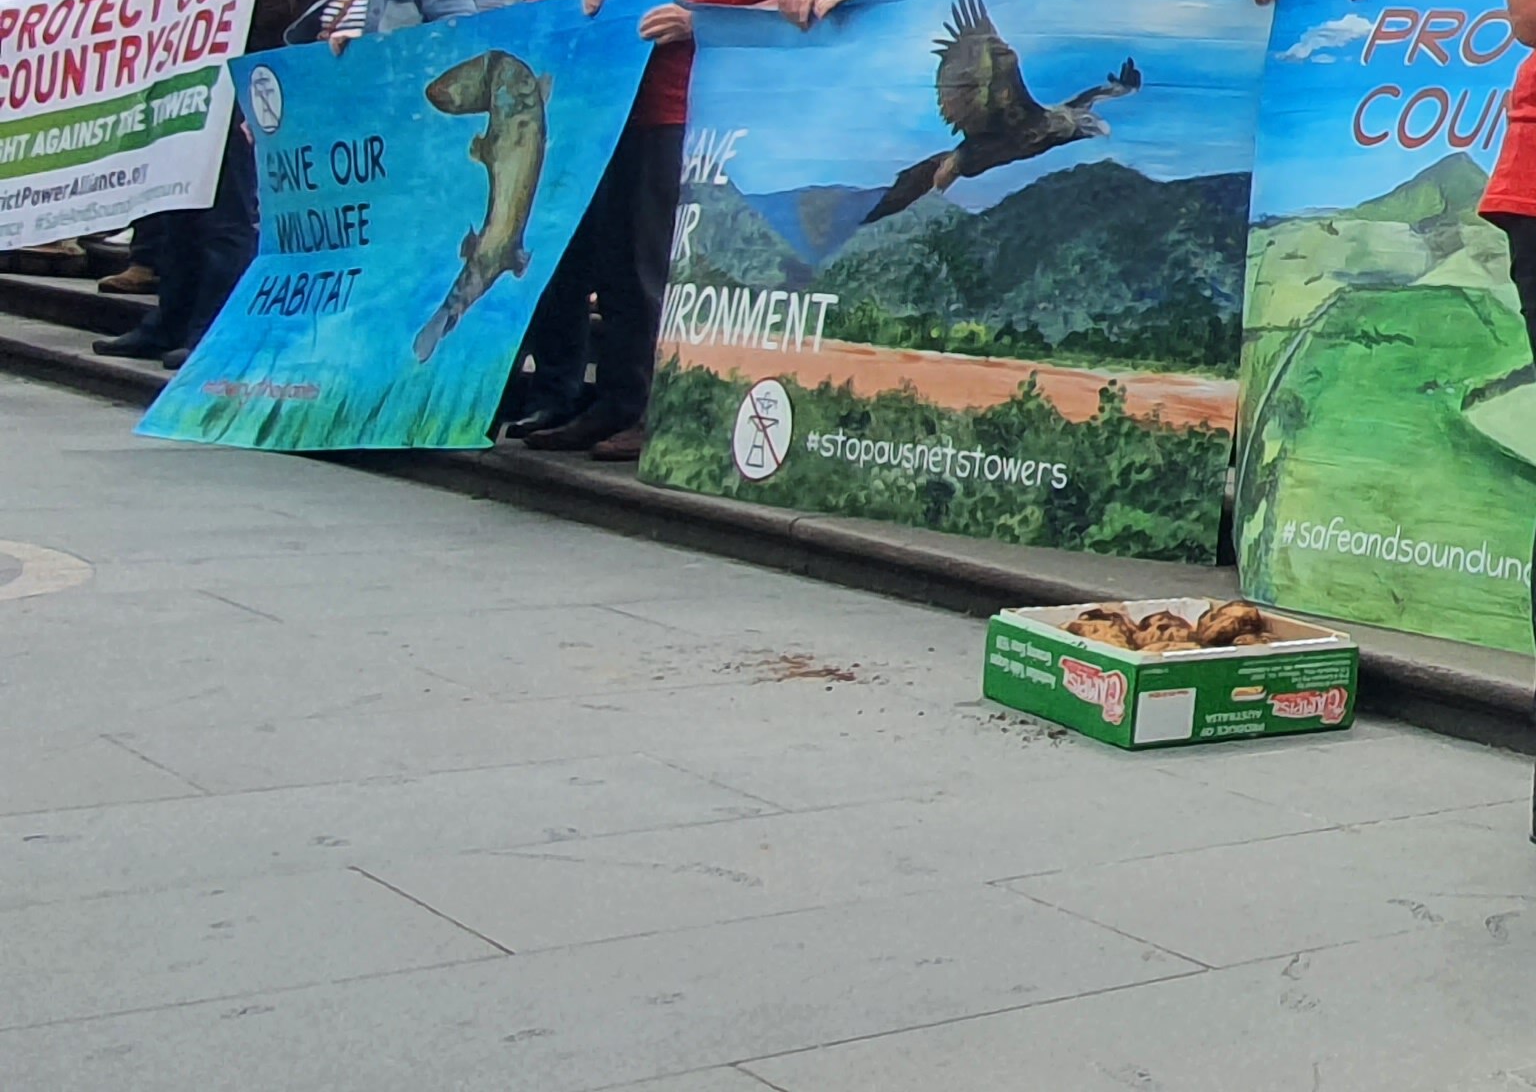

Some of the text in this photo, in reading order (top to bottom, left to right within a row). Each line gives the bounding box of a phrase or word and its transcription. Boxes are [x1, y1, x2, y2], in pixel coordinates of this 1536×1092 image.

[31, 115, 118, 157] AGAINST
[267, 135, 386, 193] SAVE OUR
[276, 203, 370, 254] WILDLIFE
[247, 268, 362, 317] HABITAT
[806, 430, 1067, 489] #stopausnetstowers
